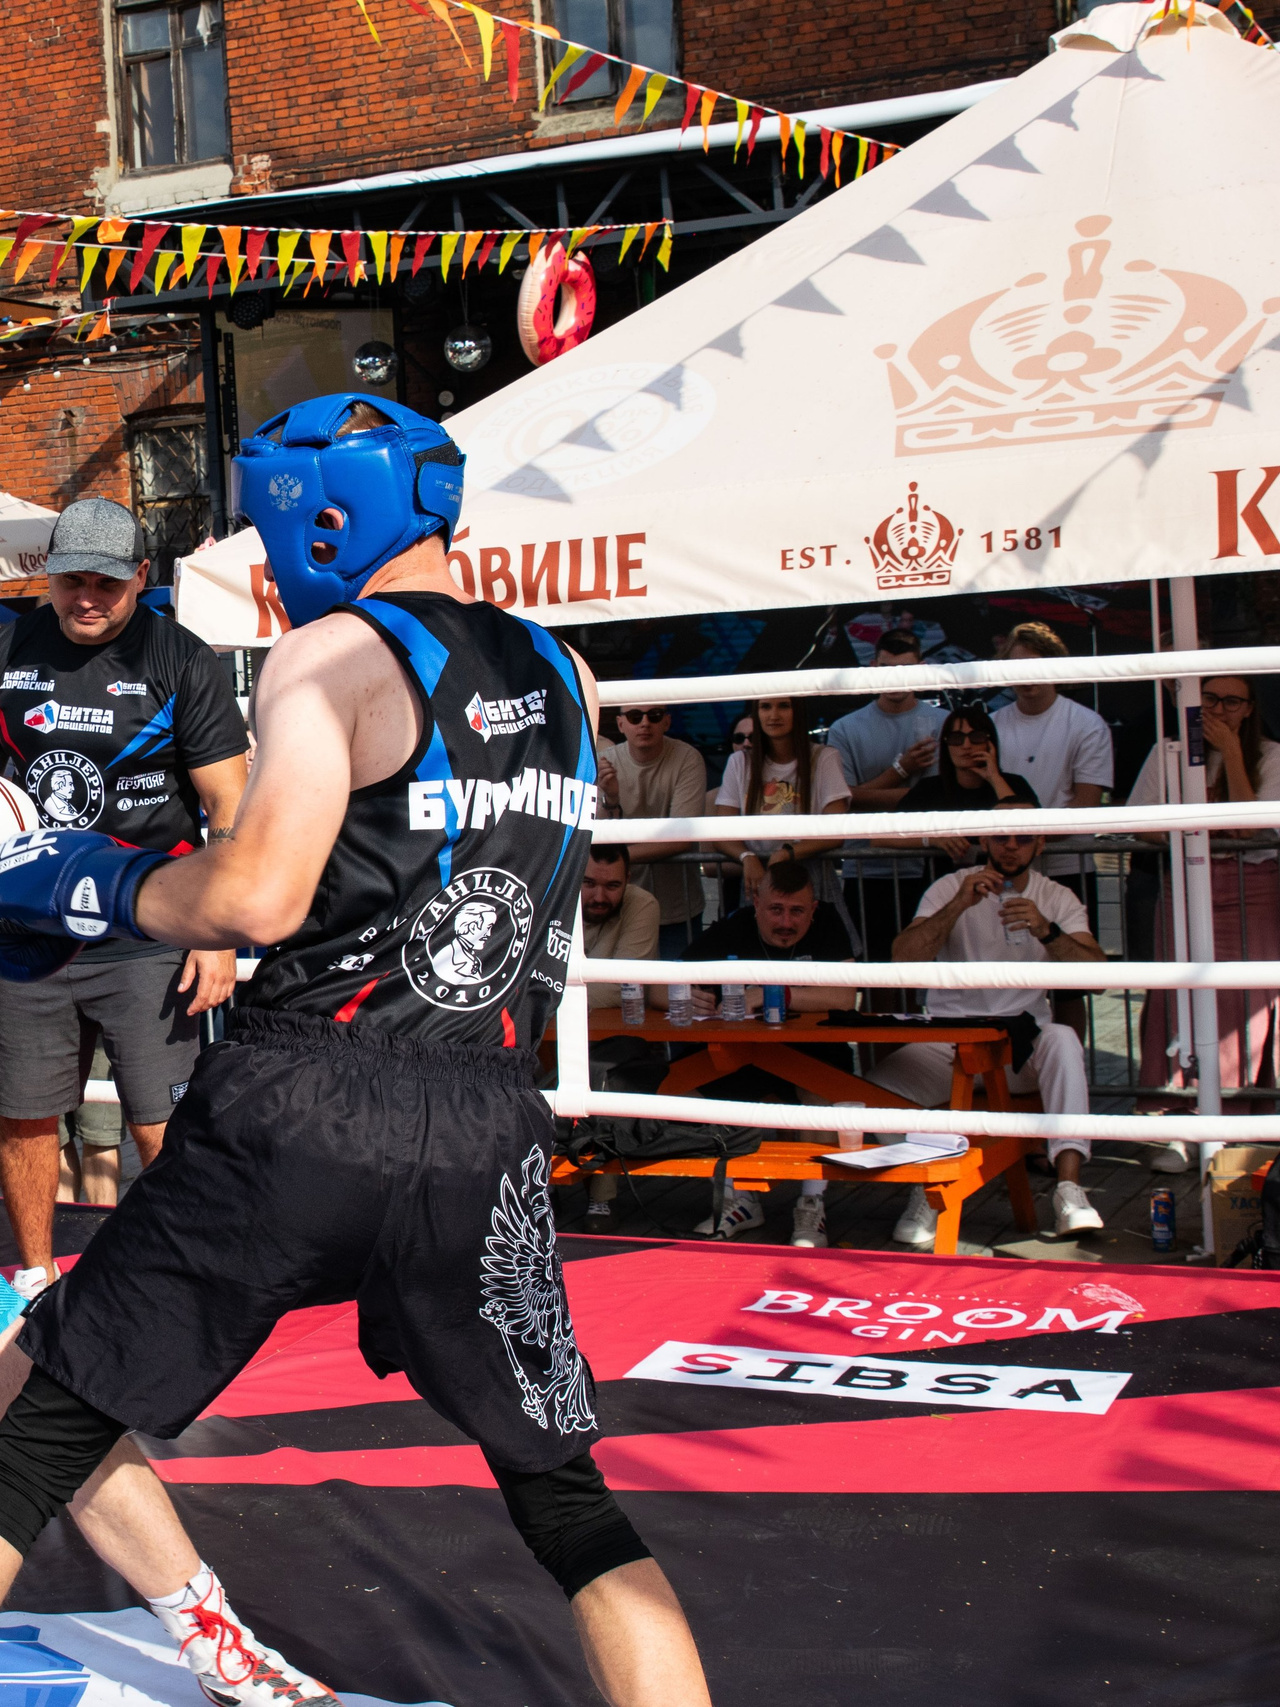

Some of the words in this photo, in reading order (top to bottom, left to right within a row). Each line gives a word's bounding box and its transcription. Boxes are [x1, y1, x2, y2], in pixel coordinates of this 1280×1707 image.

[780, 545, 852, 571] EST.
[980, 525, 1064, 554] 1581
[57, 721, 113, 735] ОБЩЕПИТОВ
[59, 705, 114, 725] БИТВА
[27, 752, 101, 802] КАНЦЛЕРЪ
[134, 794, 170, 807] LADOGA
[416, 971, 491, 1003] 2010
[740, 1289, 1137, 1335] BROOM
[851, 1324, 967, 1343] GIN
[670, 1353, 1083, 1402] SIBSA
